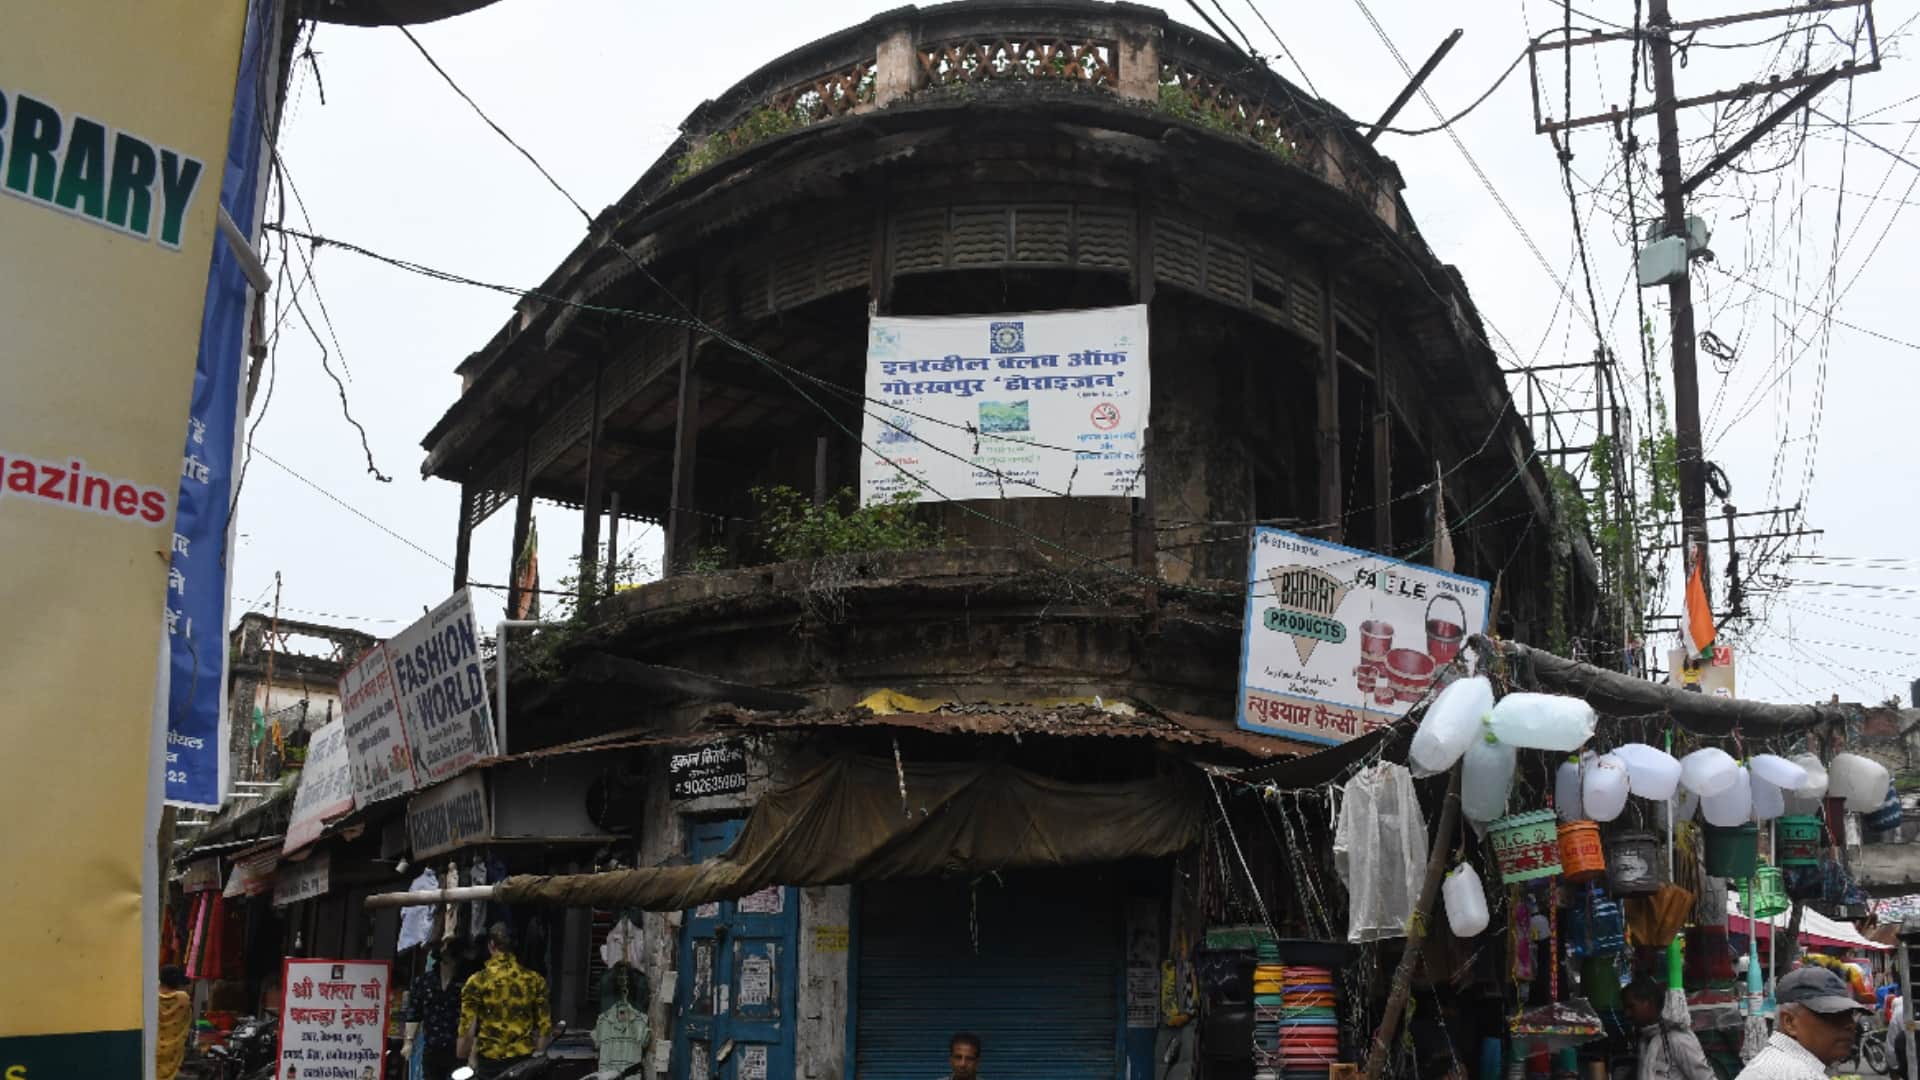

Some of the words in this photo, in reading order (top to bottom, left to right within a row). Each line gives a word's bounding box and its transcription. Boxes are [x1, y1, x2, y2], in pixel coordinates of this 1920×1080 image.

[0, 86, 202, 246] RARY
[880, 353, 990, 375] इनरव्हील
[997, 352, 1060, 370] क्लब
[880, 377, 988, 397] गोरखपुर
[0, 455, 167, 522] azines
[1281, 572, 1338, 614] BHARAT
[1271, 612, 1342, 639] PRODUCTS
[395, 613, 476, 697] FASHION
[416, 663, 482, 731] WORLD
[1315, 703, 1358, 736] फैन्सी
[292, 975, 313, 1000] श्री
